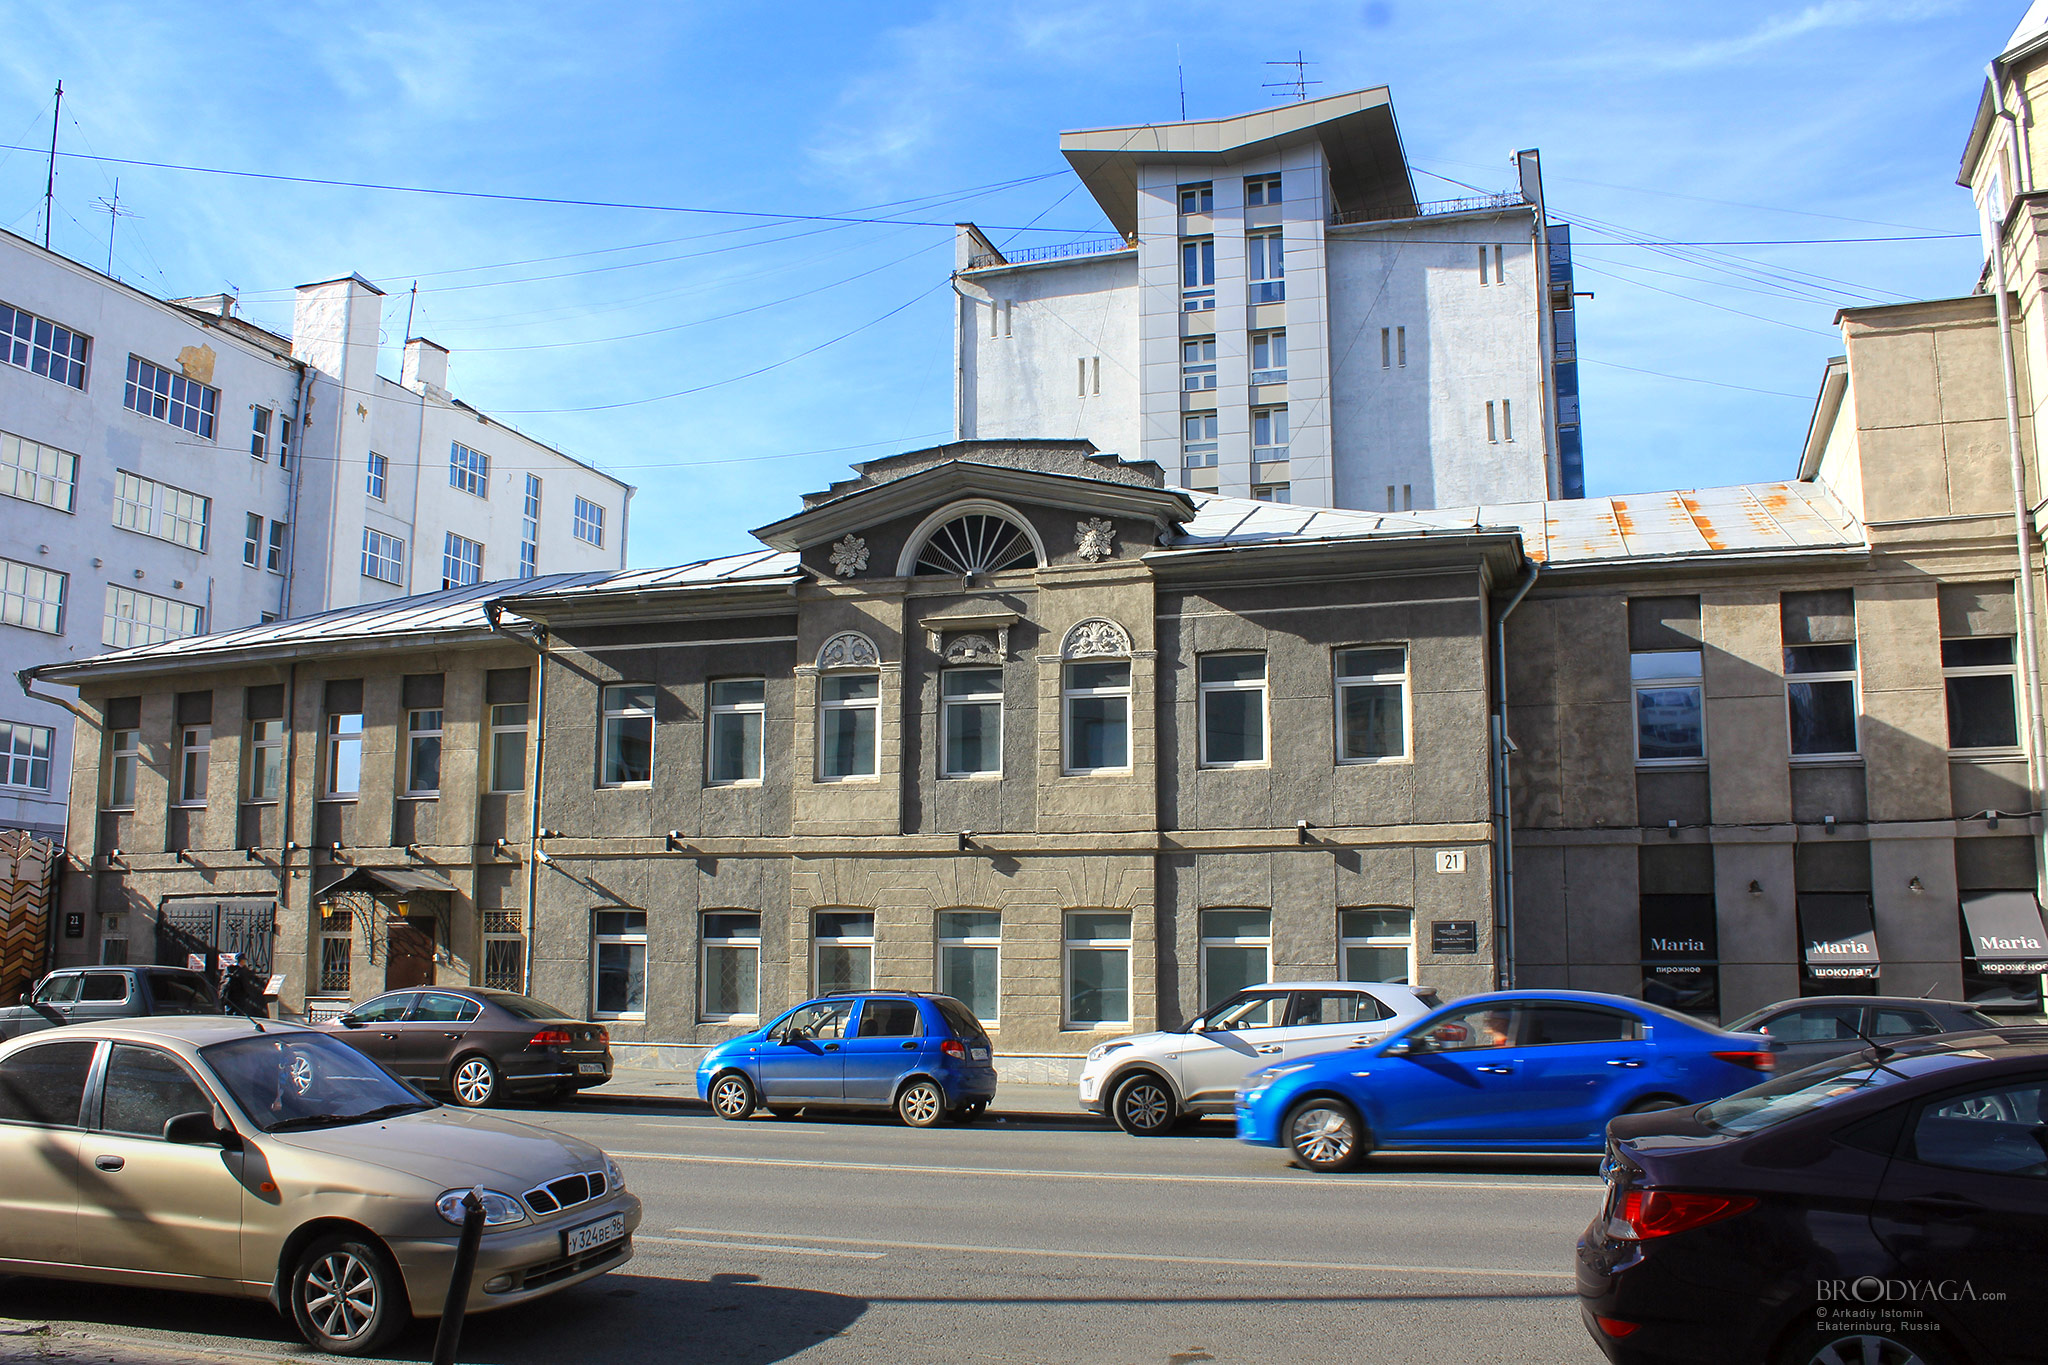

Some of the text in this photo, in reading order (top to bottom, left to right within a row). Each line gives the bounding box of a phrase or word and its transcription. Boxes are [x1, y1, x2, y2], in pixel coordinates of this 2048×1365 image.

[1445, 854, 1458, 869] 21
[70, 915, 79, 925] 21
[1651, 938, 1705, 951] Maria
[1812, 939, 1869, 954] Maria
[1979, 936, 2041, 950] Maria
[1656, 966, 1701, 974] пирожное
[1815, 968, 1873, 977] шоколад
[1982, 963, 2048, 974] мороженое
